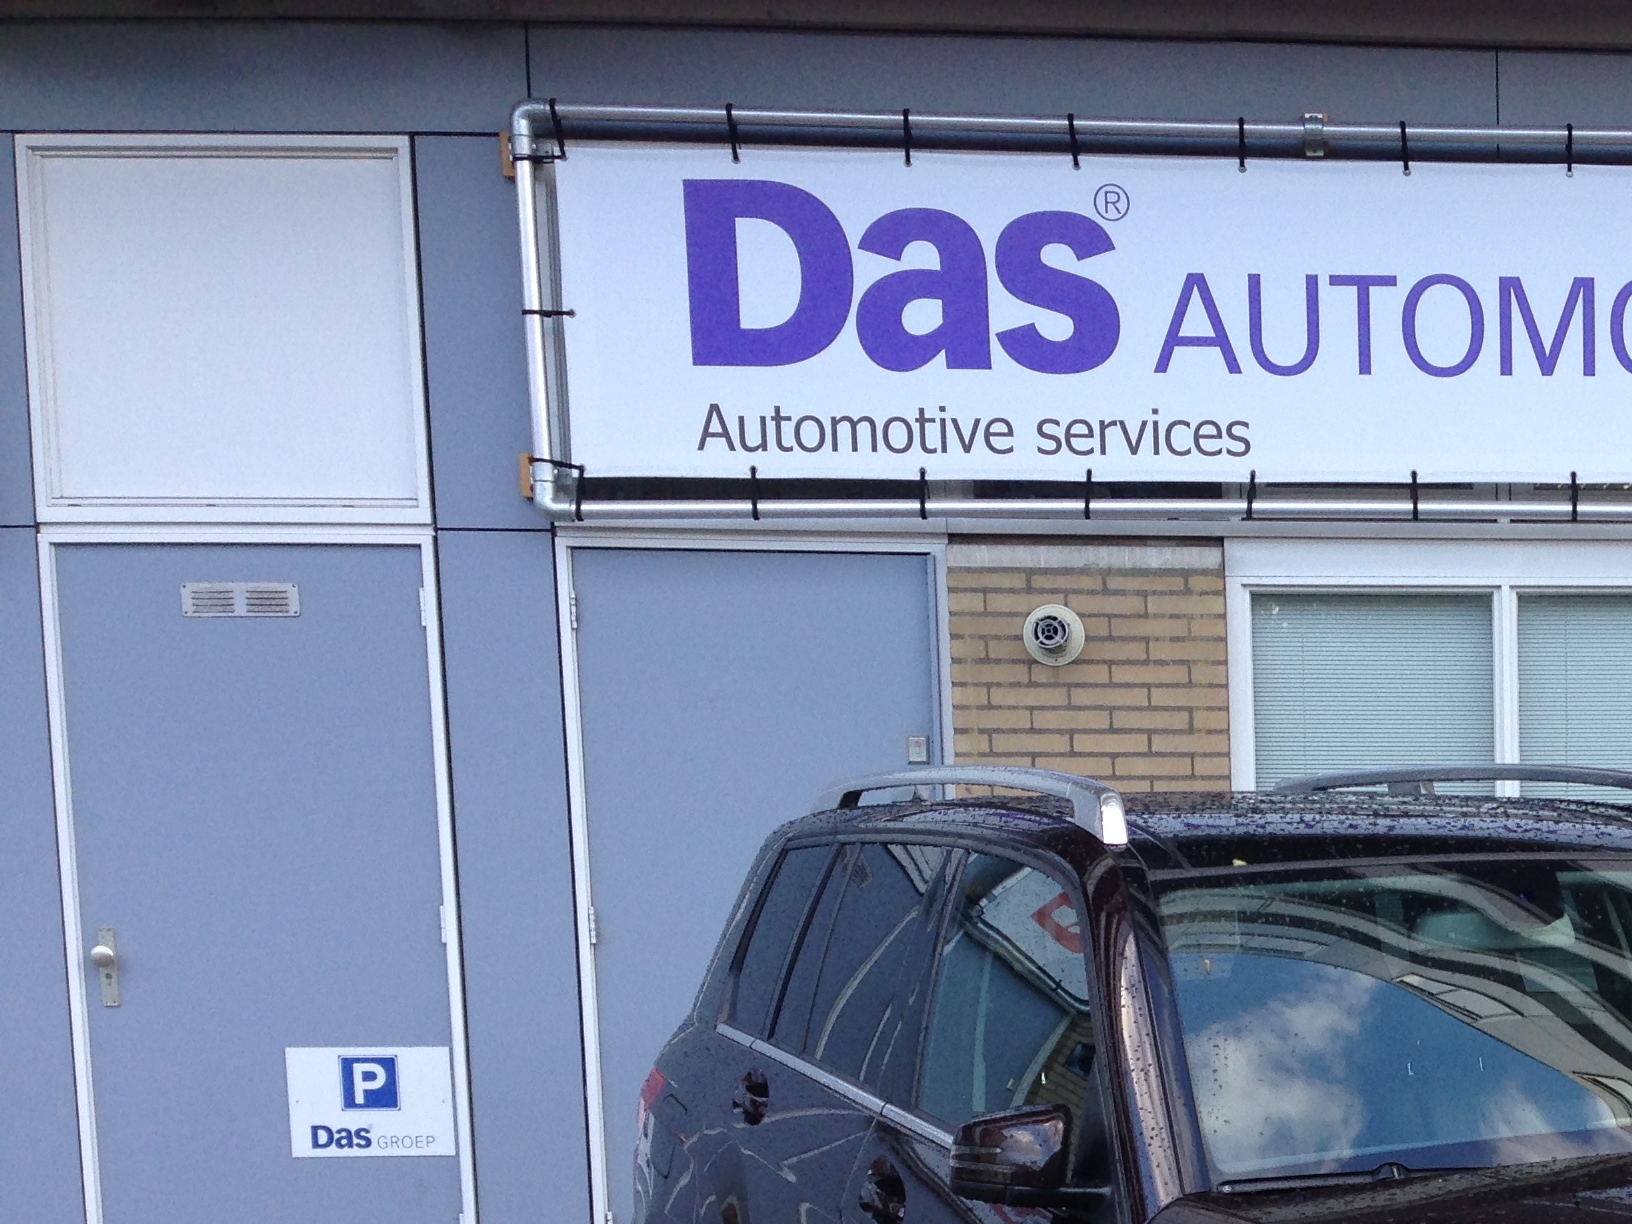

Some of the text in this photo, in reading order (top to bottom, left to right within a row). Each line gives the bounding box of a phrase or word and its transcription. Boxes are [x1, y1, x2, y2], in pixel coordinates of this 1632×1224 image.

[697, 403, 1251, 457] Automotive services
[352, 1062, 387, 1105] P
[310, 1124, 436, 1150] Das GROEP
